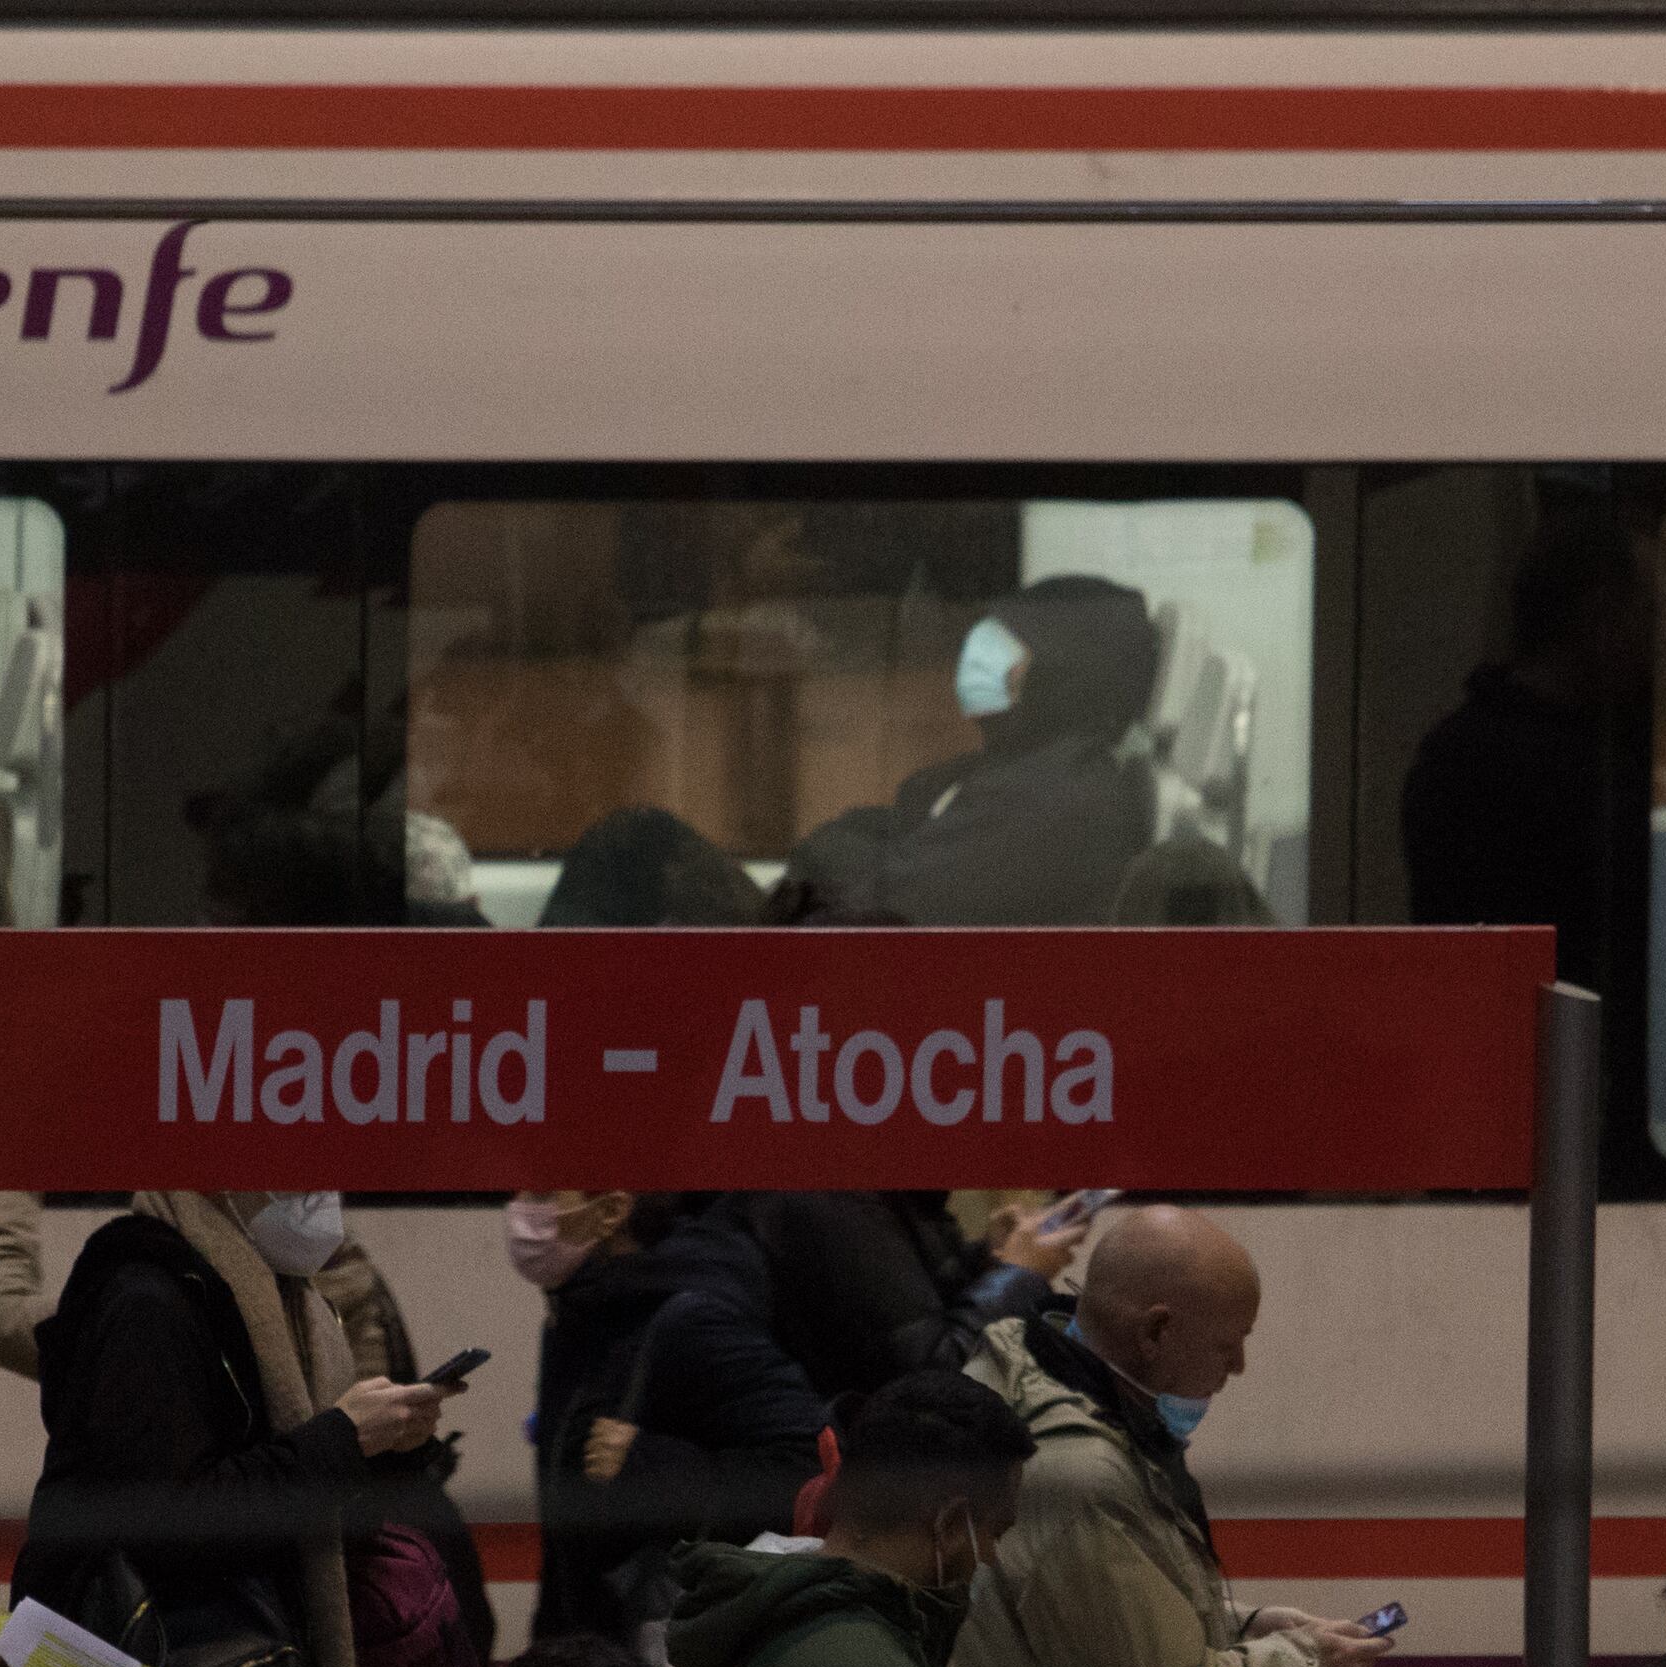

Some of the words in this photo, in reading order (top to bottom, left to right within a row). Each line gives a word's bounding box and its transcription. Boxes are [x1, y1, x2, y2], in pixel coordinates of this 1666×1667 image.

[158, 997, 548, 1126] Madrid
[602, 1048, 659, 1073] -
[709, 997, 1115, 1127] Atocha
